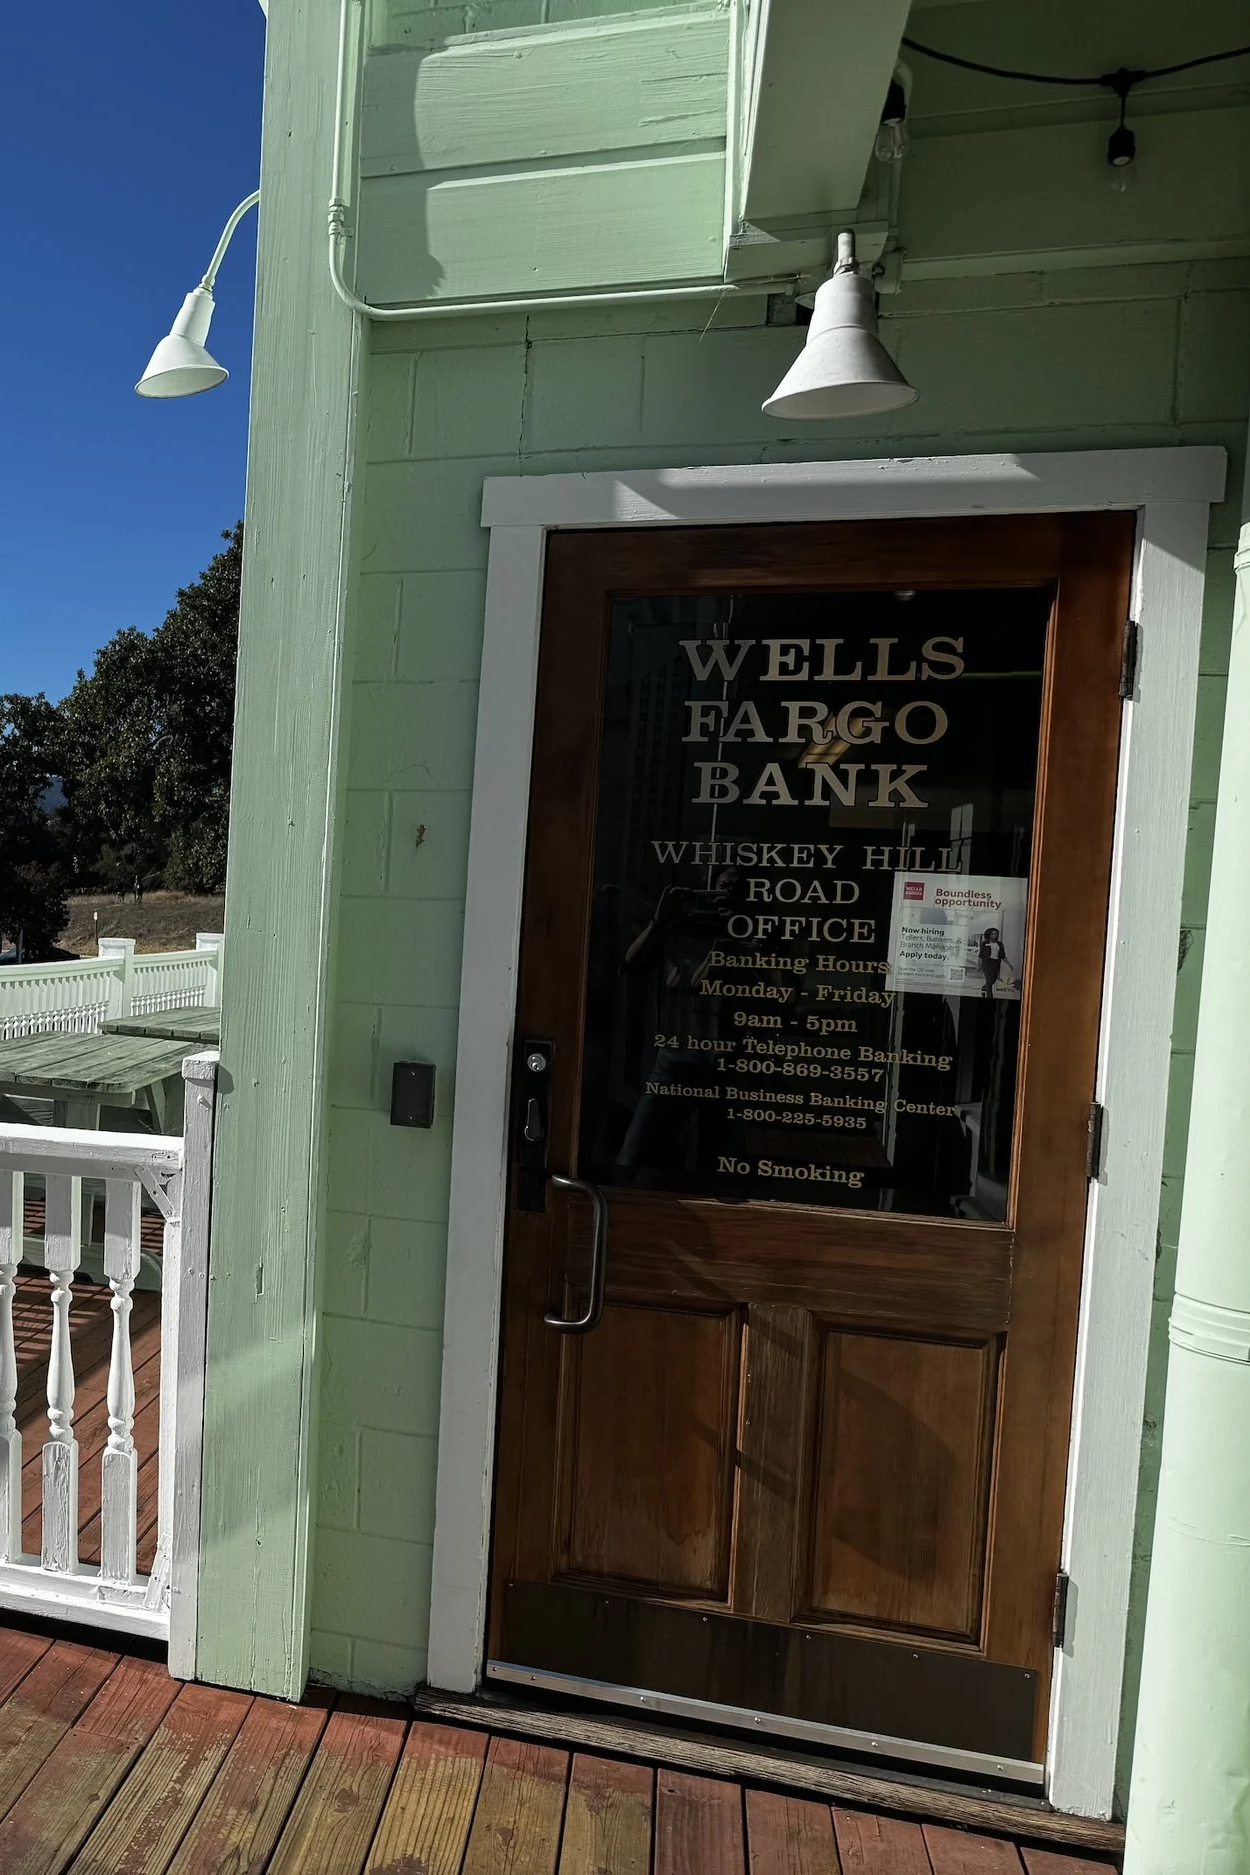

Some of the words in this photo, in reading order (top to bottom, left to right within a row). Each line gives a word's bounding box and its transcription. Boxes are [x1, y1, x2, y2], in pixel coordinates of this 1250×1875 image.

[679, 636, 966, 681] WELLS
[681, 700, 948, 745] FARGO
[692, 761, 928, 808] BANK
[651, 841, 844, 868] WHISKEY
[862, 846, 963, 872] HILL
[746, 878, 860, 904] ROAD
[935, 898, 1001, 910] opportunity
[936, 888, 992, 899] Boundless
[727, 915, 875, 943] OFFICE
[921, 928, 945, 936] hiring
[709, 950, 808, 974] Banking
[816, 955, 893, 976] Hours
[900, 950, 922, 959] Apply
[924, 952, 949, 961] today.
[699, 980, 793, 1002] Monday
[816, 984, 896, 1008] Friday
[733, 1011, 782, 1029] 9am
[806, 1015, 858, 1034] 5pm
[654, 1034, 679, 1049] 24
[687, 1036, 736, 1054] hour
[743, 1038, 851, 1062] Telephone
[858, 1045, 953, 1071] Banking
[717, 1058, 884, 1083] 1-800-869-3557
[645, 1083, 720, 1099] National
[726, 1087, 804, 1105] Business
[810, 1092, 886, 1113] Banking
[893, 1098, 956, 1117] Center
[727, 1108, 867, 1129] 1-800-225-5935
[717, 1156, 750, 1176] No
[758, 1160, 865, 1188] Smoking
